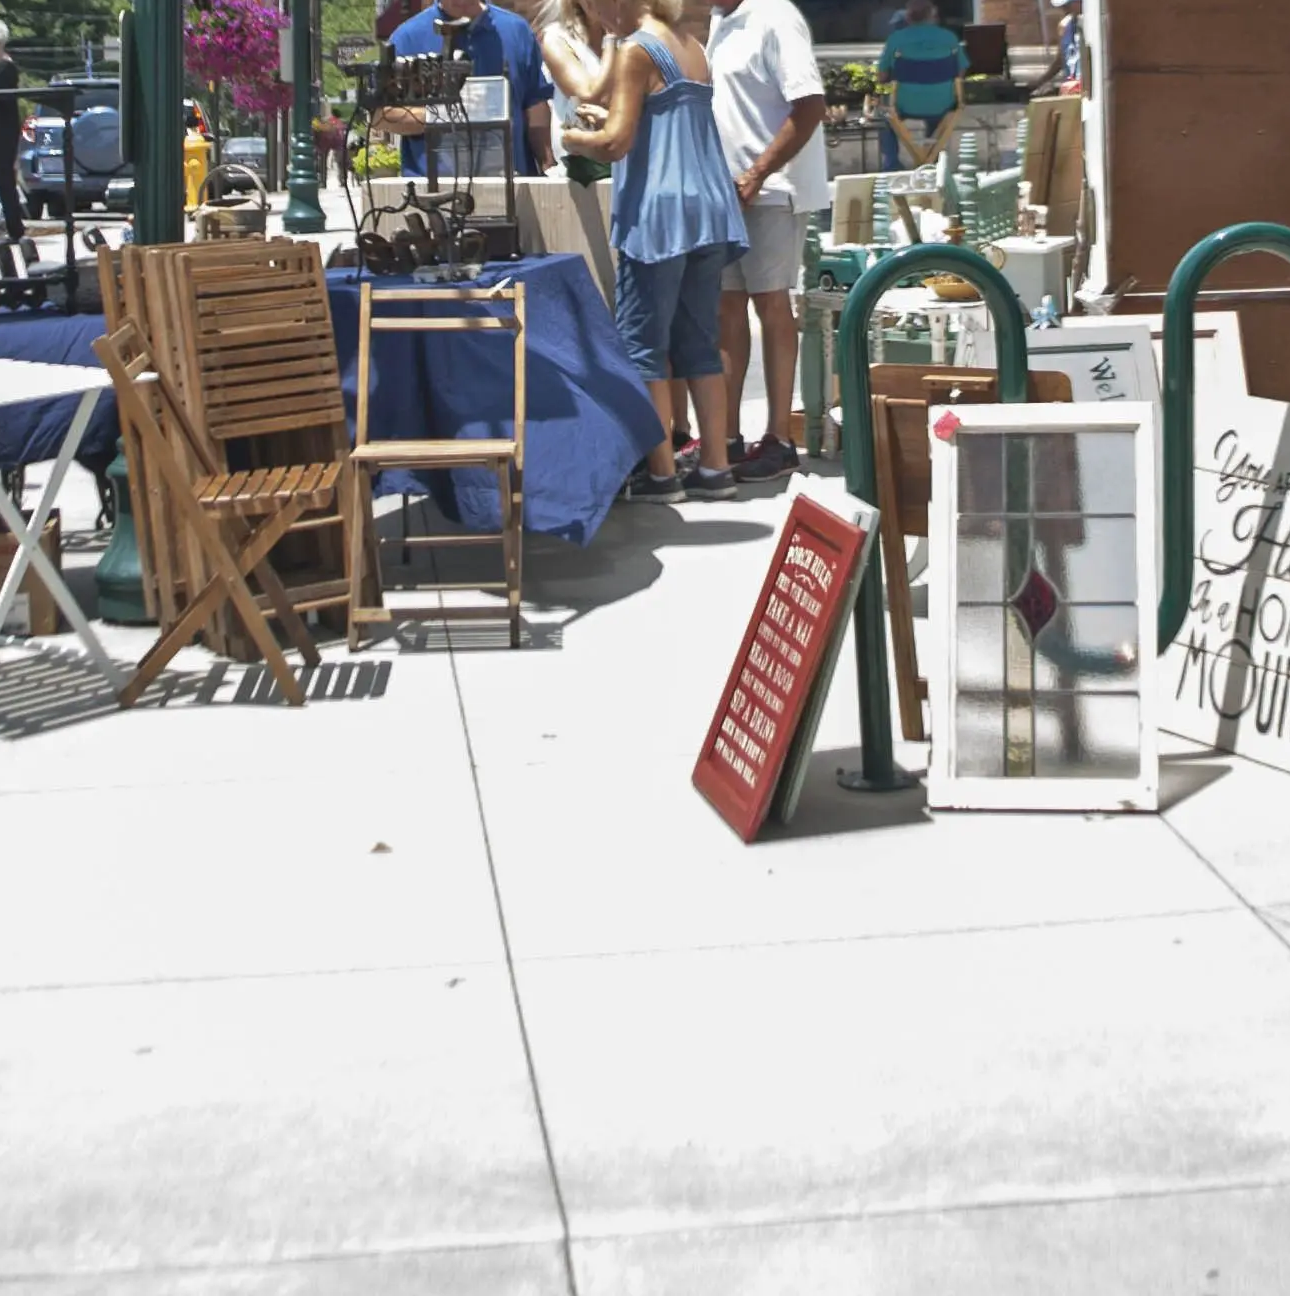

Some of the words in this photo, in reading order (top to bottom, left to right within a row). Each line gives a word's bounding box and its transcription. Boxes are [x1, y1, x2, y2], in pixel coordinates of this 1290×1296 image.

[1214, 429, 1271, 503] You
[765, 593, 789, 627] TAKE
[785, 612, 795, 632] A
[748, 640, 769, 672] READ
[730, 688, 746, 714] SIP
